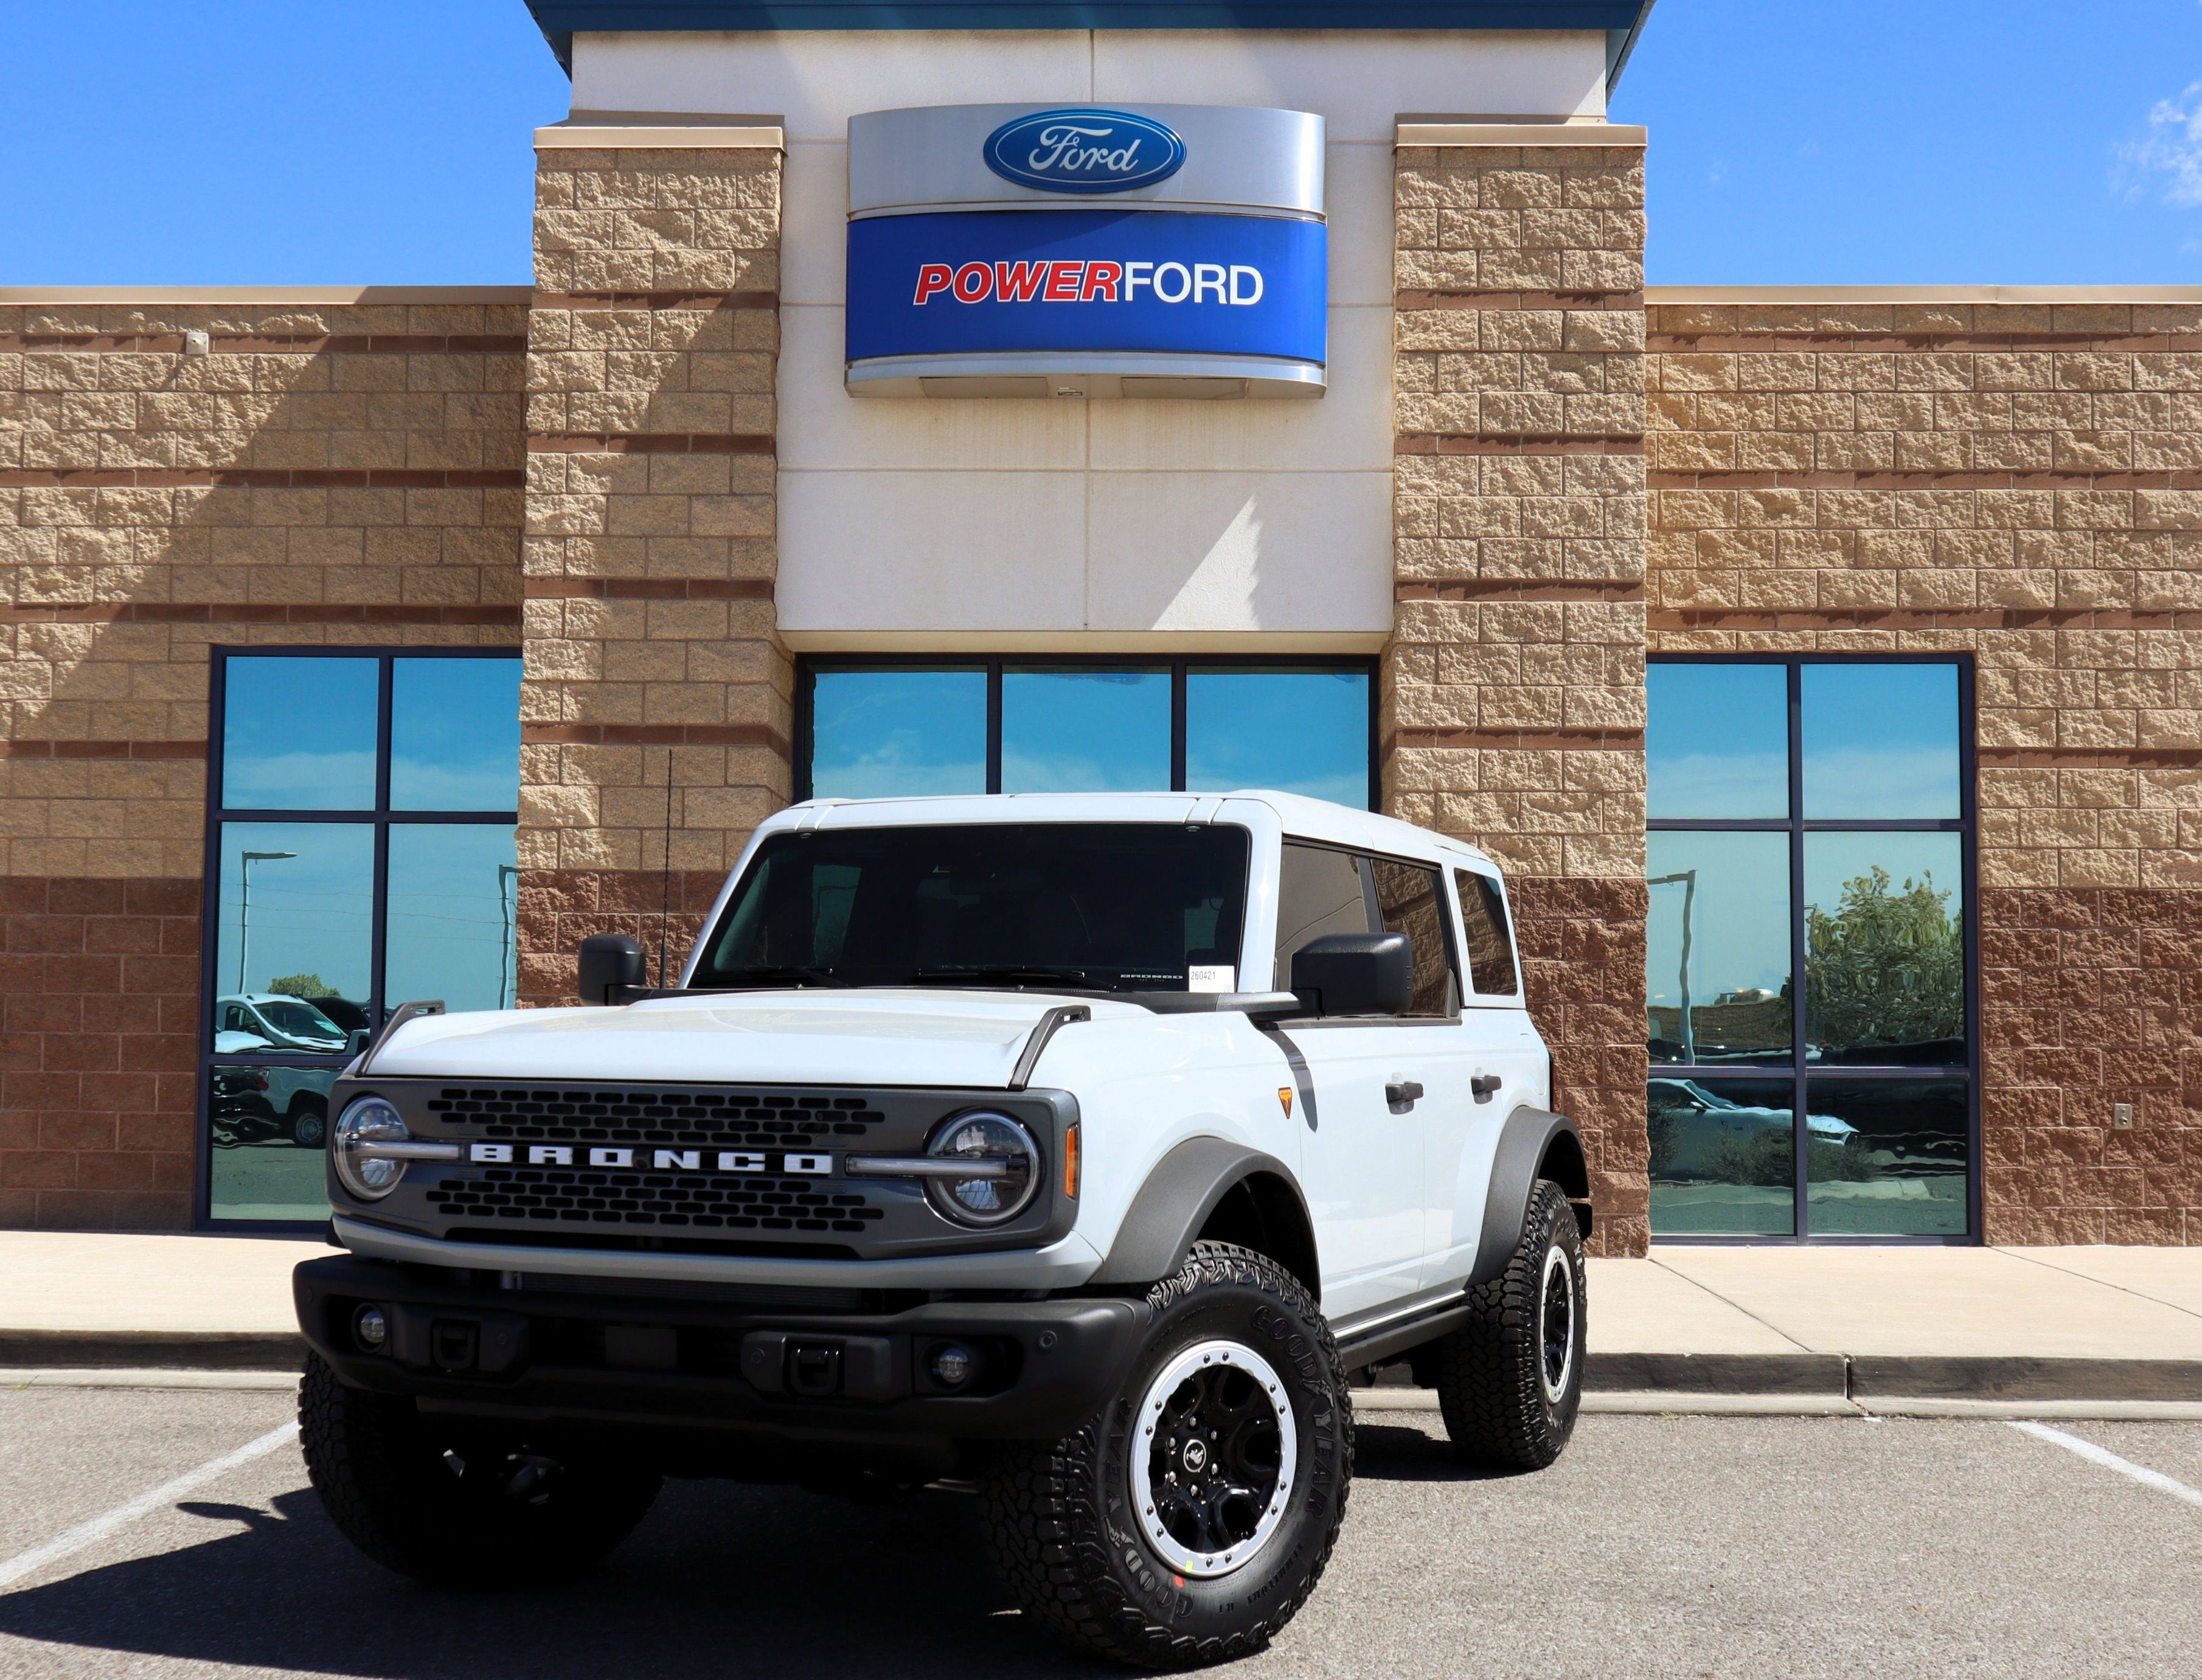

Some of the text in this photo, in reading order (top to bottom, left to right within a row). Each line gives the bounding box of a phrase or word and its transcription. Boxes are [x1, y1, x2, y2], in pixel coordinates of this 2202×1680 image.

[1028, 125, 1142, 172] Ford
[912, 260, 1264, 306] POWERFORD
[1190, 970, 1217, 981] 260421
[470, 1144, 832, 1173] BRONCO
[1249, 1304, 1335, 1519] GOODYEAR
